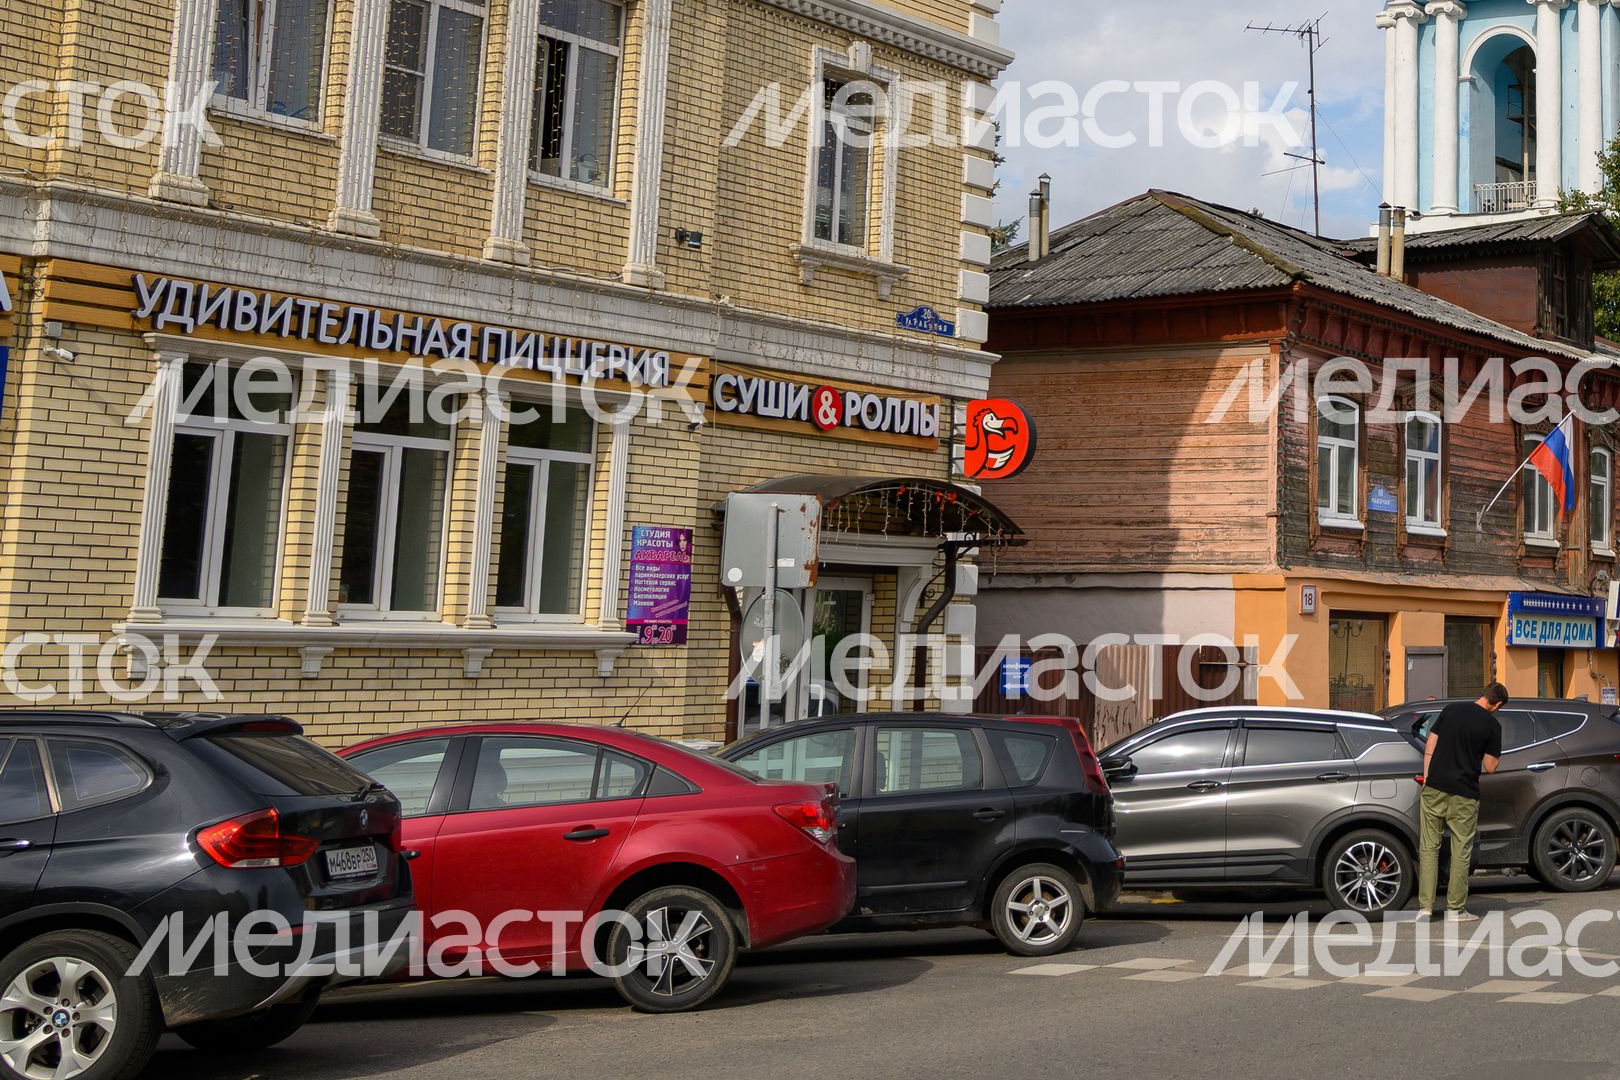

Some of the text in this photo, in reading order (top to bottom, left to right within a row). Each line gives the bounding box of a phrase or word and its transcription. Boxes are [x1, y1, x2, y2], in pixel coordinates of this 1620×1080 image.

[133, 273, 670, 386] УДИВИТЕЛЬНАЯ ПИЦЦЕРИЯ
[714, 372, 809, 422] СУШИ
[844, 391, 940, 438] РОЛЛЫ
[640, 529, 671, 539] СТУДИЯ
[637, 539, 674, 548] КРАСОТЫ
[635, 549, 690, 563] АКВАРЕЛЬ
[1304, 593, 1313, 606] 18
[1515, 619, 1593, 644] ВСЕ ДЛЯ ДОМА
